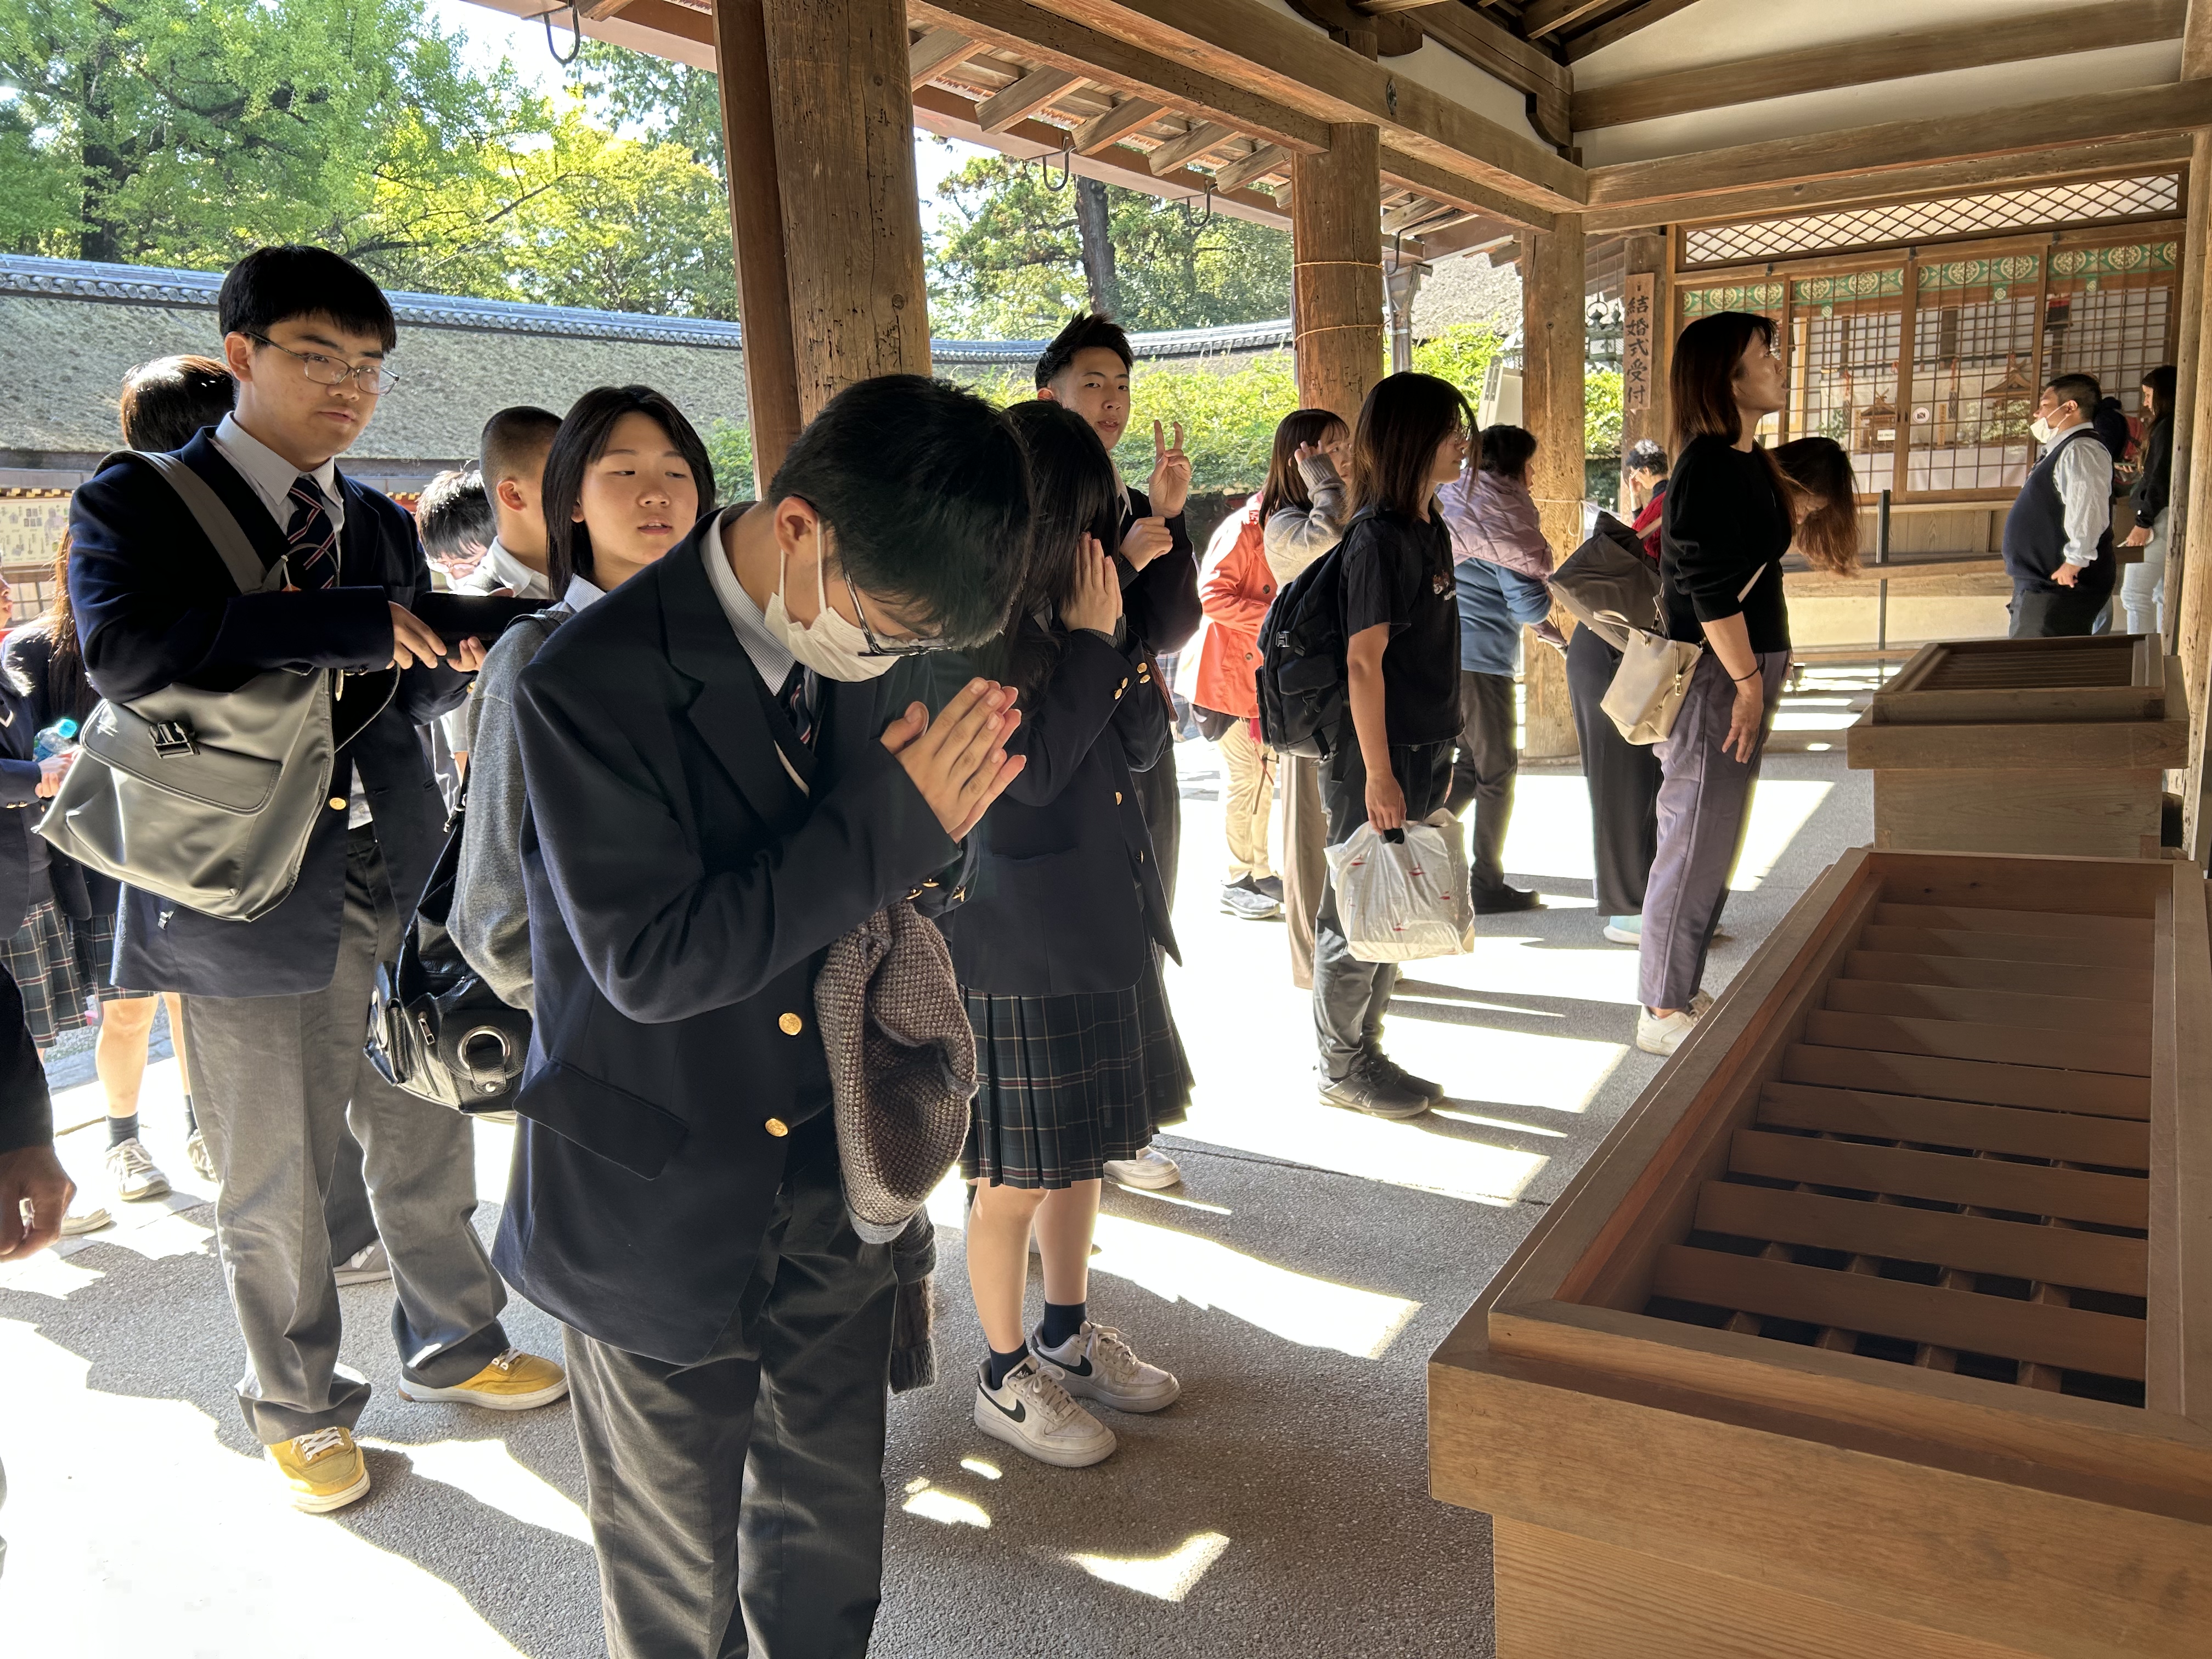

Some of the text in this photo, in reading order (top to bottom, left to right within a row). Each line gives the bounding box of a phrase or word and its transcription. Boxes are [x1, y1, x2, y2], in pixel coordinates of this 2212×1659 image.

[1626, 295, 1649, 404] 結婚式受付
